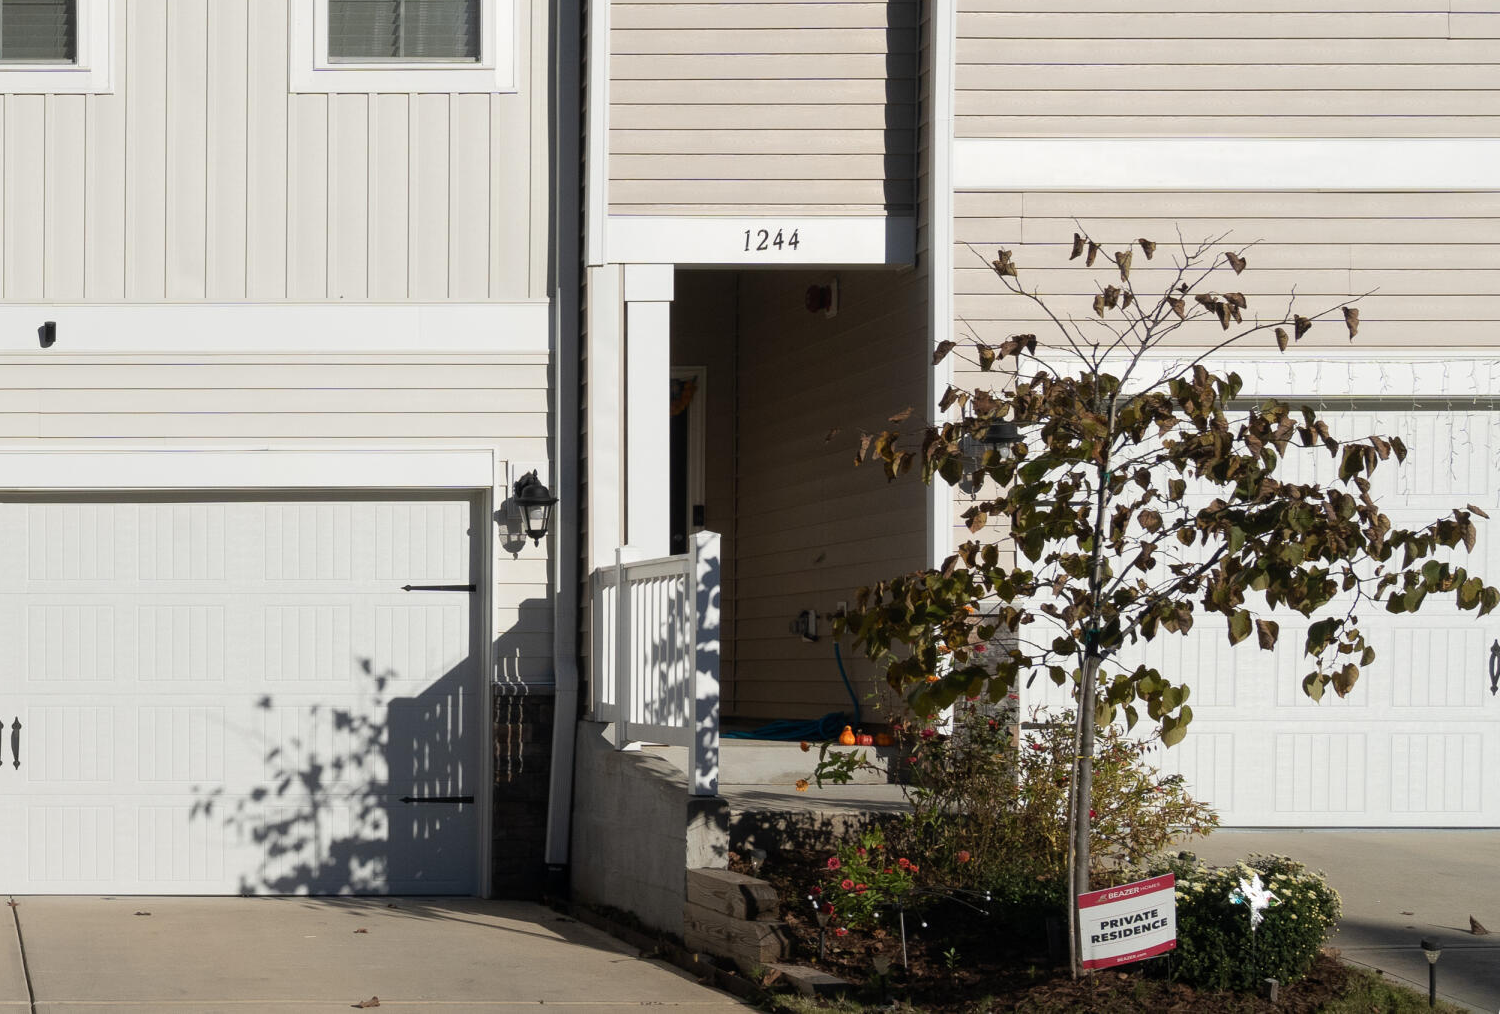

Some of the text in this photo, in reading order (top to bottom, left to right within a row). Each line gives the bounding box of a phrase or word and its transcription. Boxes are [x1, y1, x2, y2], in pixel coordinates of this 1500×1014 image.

[743, 228, 800, 252] 1244
[1108, 886, 1140, 900] BEAZER
[1091, 918, 1168, 944] RESIDENCE
[1100, 909, 1158, 931] PRIVATE
